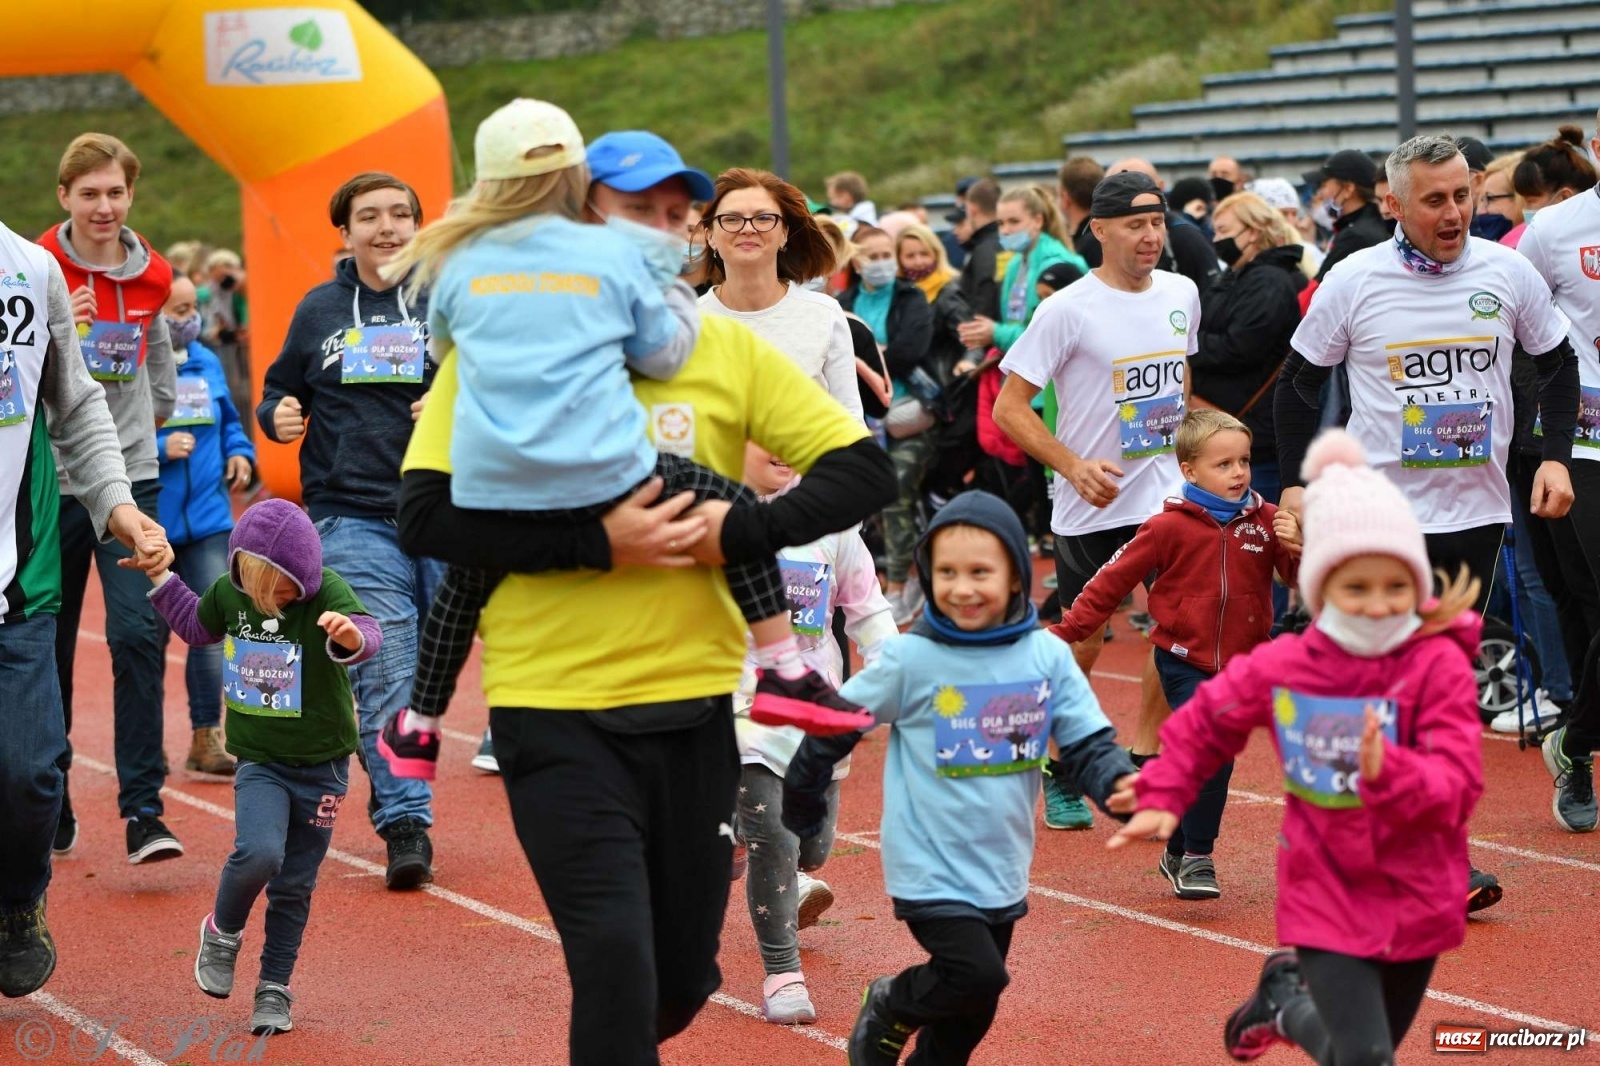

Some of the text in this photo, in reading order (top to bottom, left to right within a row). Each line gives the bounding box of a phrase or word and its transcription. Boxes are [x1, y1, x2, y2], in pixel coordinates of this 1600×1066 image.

[99, 341, 112, 350] DLA
[371, 345, 386, 353] DLA
[1128, 421, 1144, 429] BIEG
[1146, 418, 1158, 427] DLA
[1414, 426, 1433, 435] BIEG
[1437, 426, 1452, 435] DLA
[1162, 434, 1176, 446] 13
[1456, 444, 1484, 459] 142
[241, 666, 255, 677] DLA
[260, 692, 291, 710] 081
[950, 717, 977, 730] BIEG
[982, 716, 1003, 729] DLA
